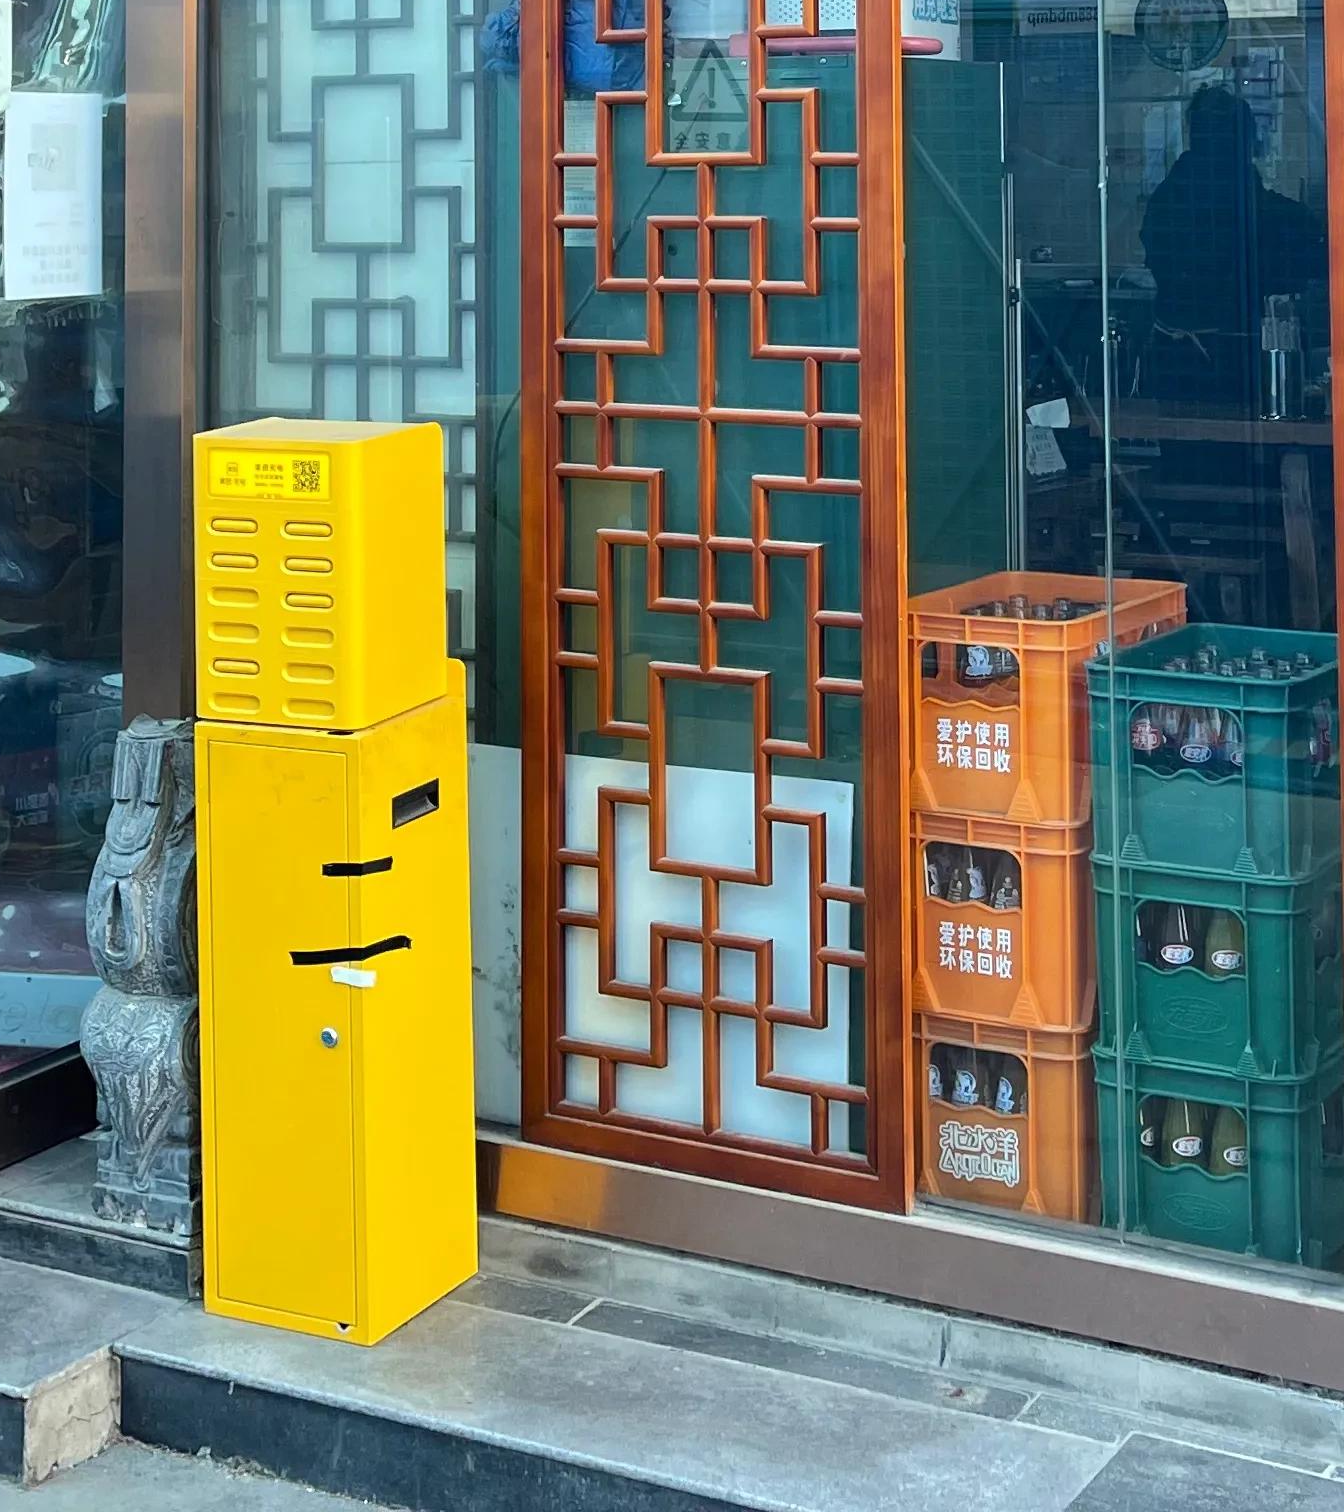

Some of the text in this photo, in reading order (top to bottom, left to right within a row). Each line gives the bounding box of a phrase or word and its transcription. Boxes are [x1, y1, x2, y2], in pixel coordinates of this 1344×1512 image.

[936, 717, 1010, 748] 爱护使用
[936, 743, 1011, 773] 环保回收
[939, 920, 1011, 954] 爱护使用
[939, 946, 1013, 979] 环保回收
[940, 1121, 1018, 1157] 北冰洋
